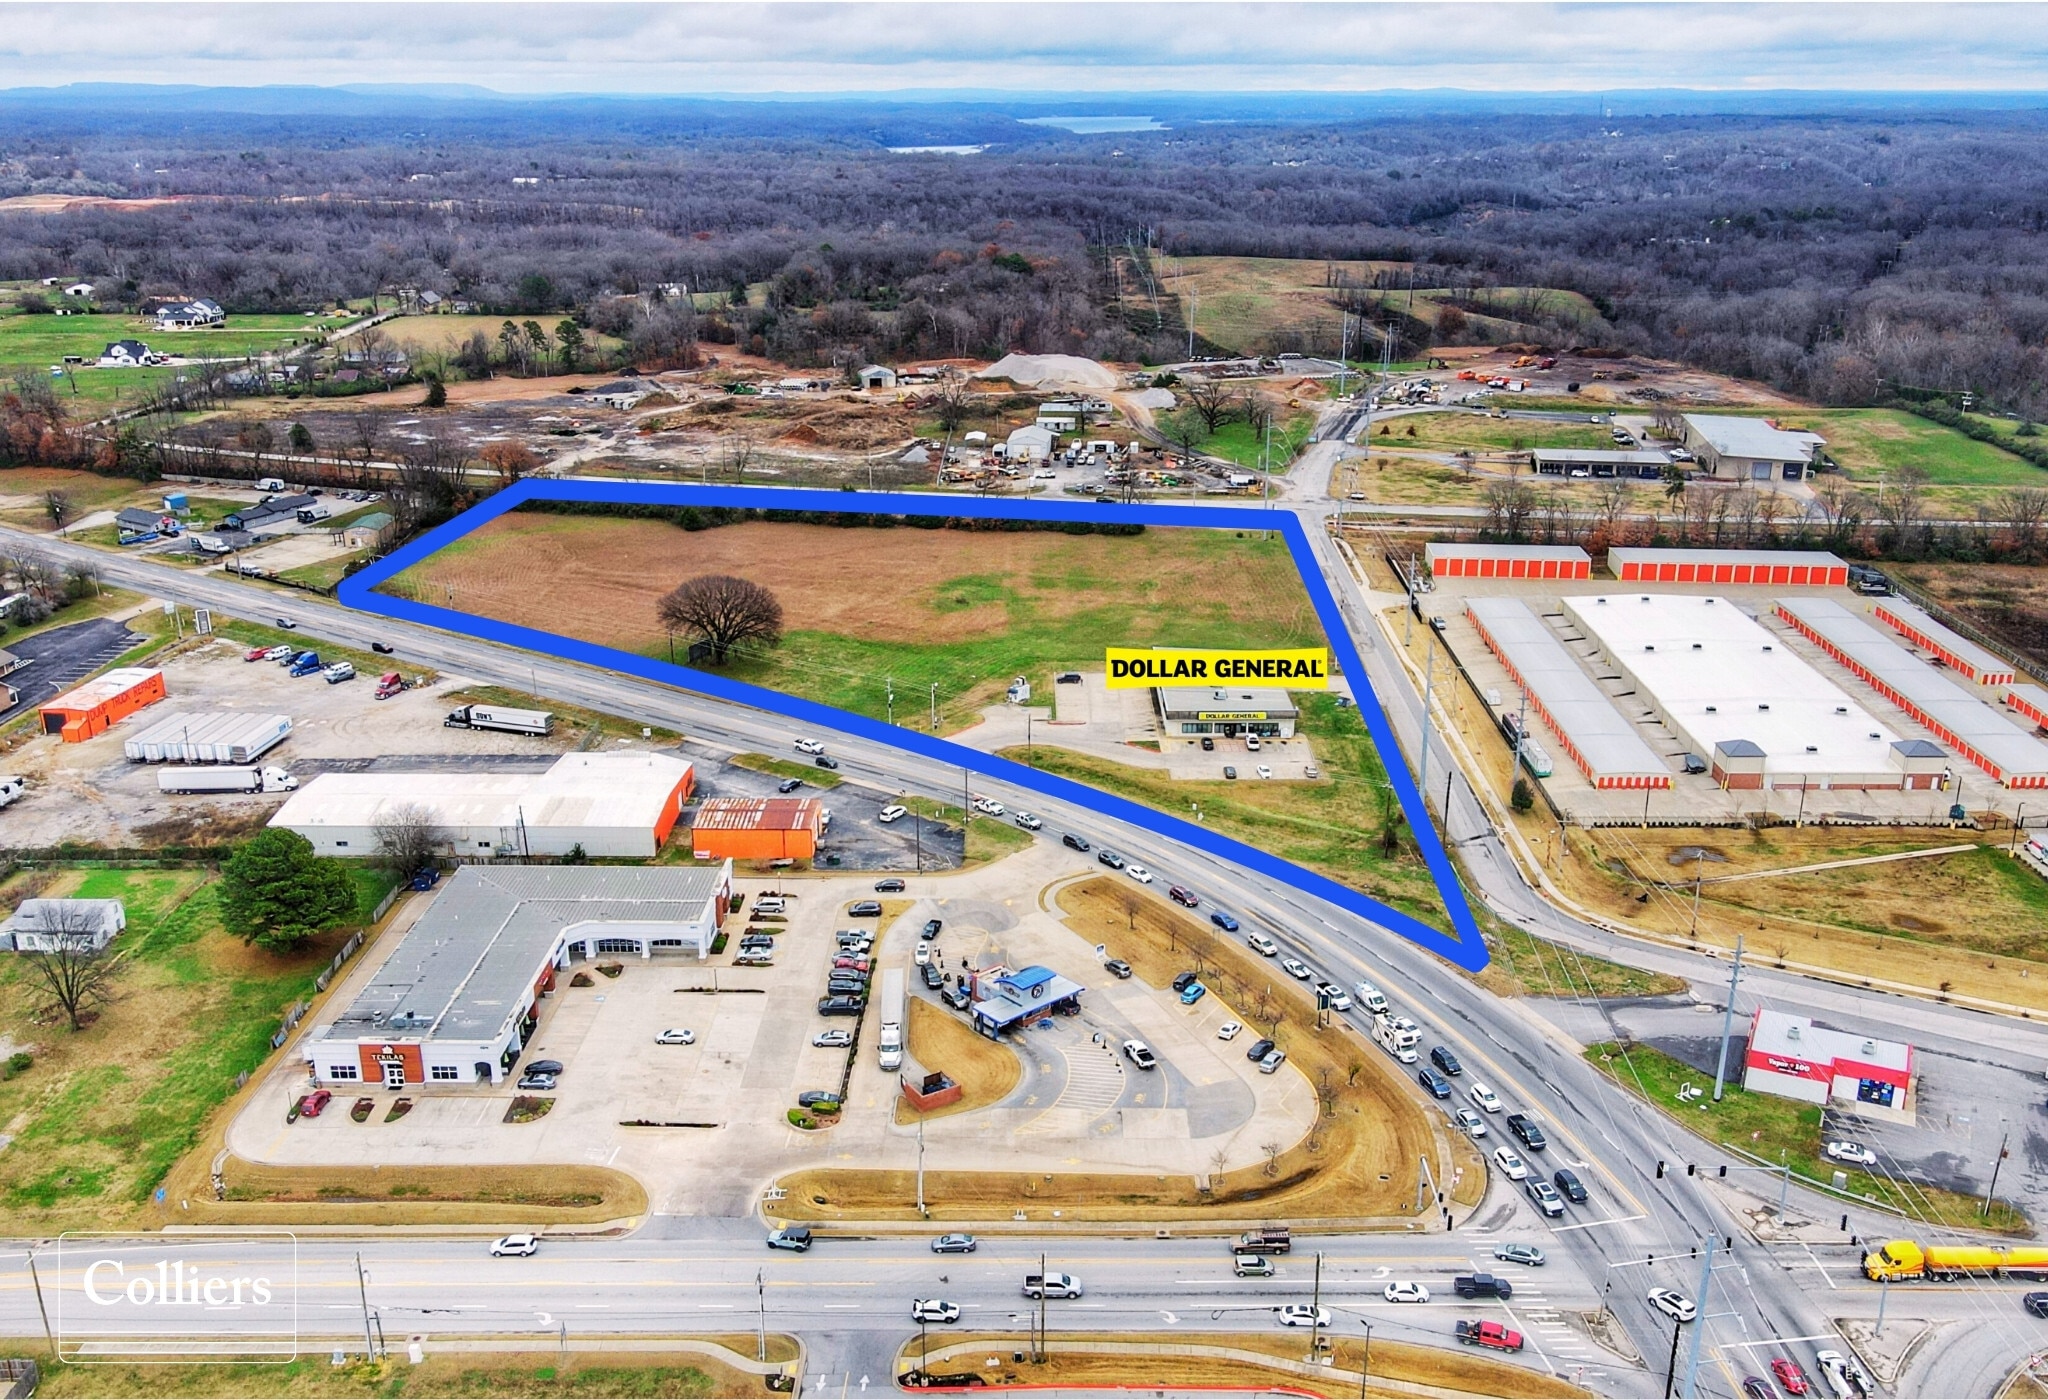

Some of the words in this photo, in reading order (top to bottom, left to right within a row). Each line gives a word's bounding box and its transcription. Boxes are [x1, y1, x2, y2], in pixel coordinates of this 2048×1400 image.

[111, 692, 131, 709] TRUCK
[133, 679, 157, 697] REPAIRS
[1794, 1063, 1811, 1072] 100
